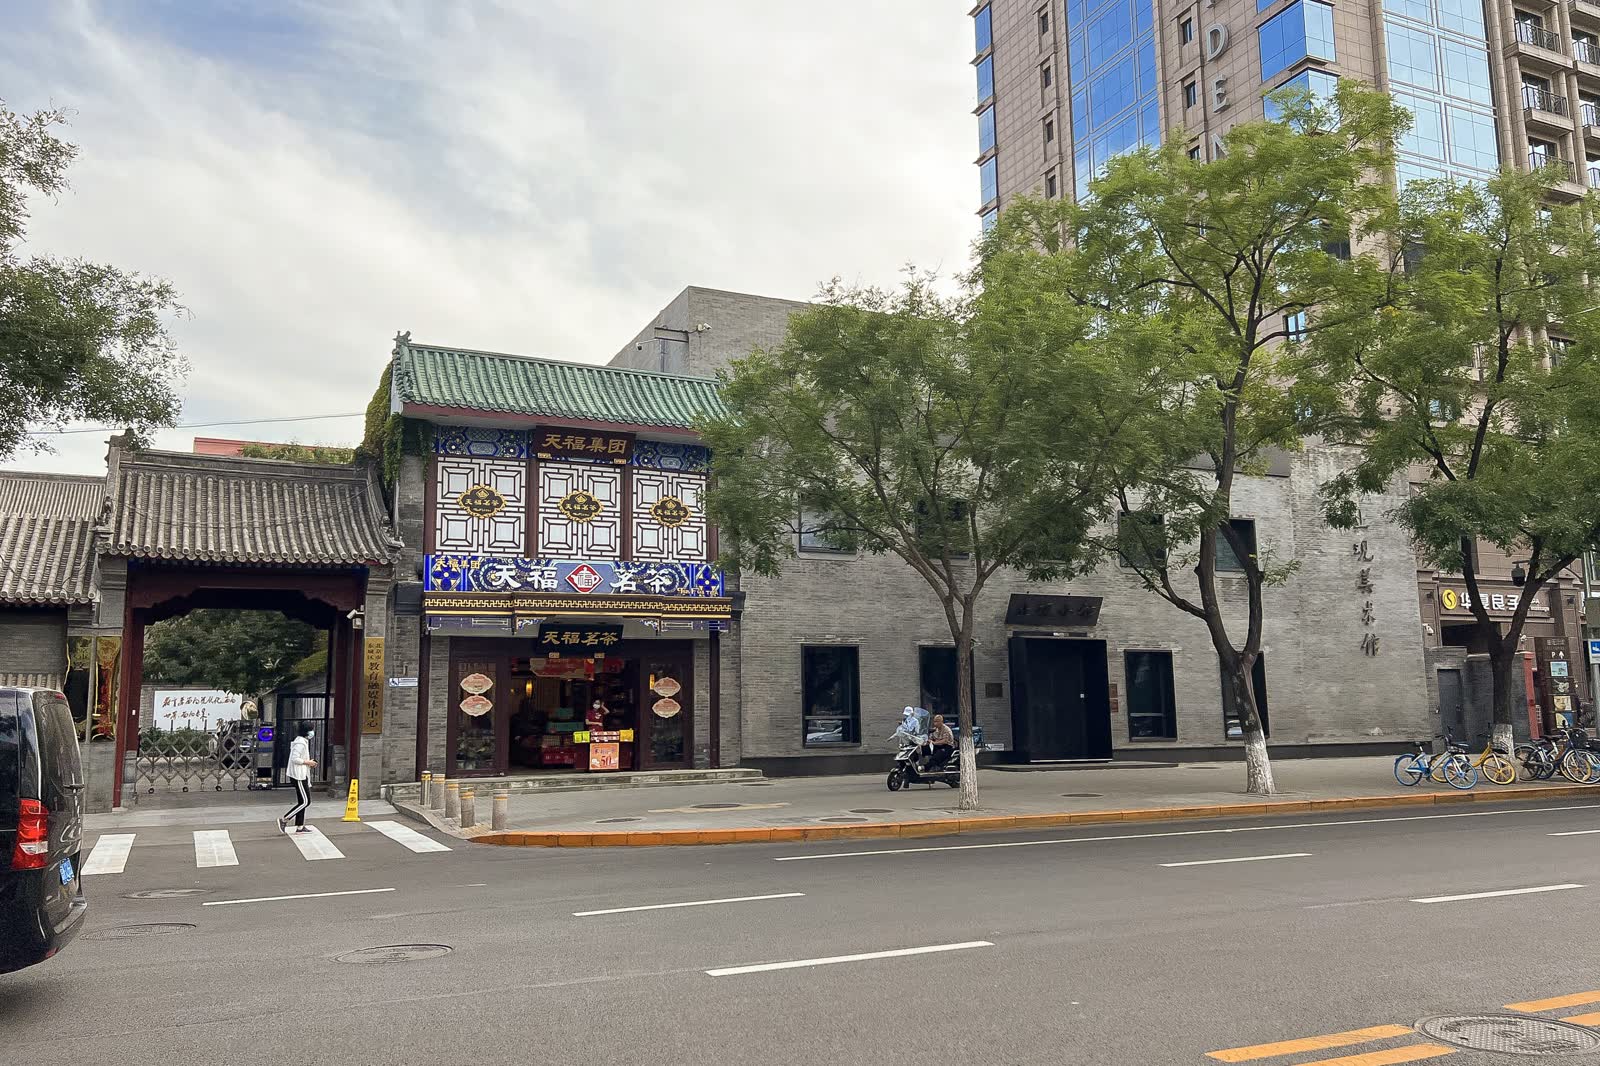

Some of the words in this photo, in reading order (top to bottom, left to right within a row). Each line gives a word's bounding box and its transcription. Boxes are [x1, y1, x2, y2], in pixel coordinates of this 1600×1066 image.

[542, 433, 627, 454] 天福集团
[435, 558, 480, 569] 天福集团
[542, 631, 618, 646] 天福茗茶
